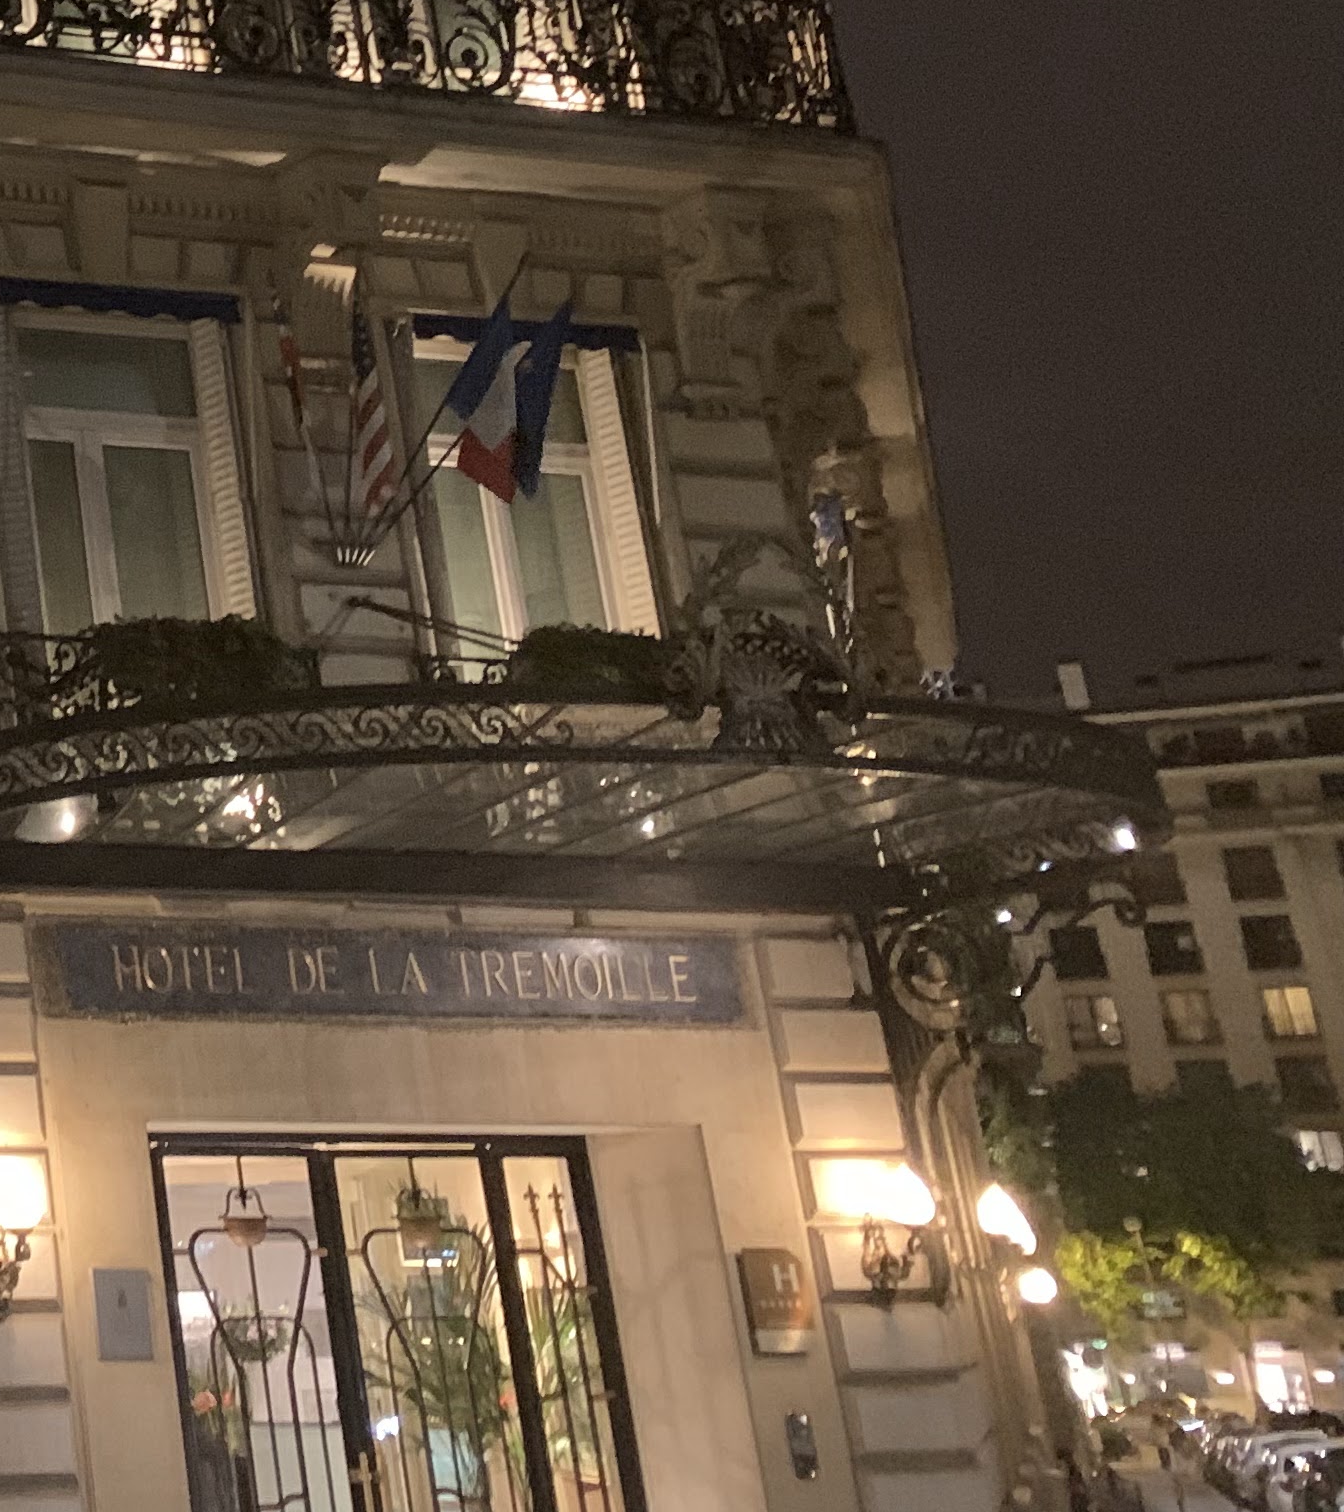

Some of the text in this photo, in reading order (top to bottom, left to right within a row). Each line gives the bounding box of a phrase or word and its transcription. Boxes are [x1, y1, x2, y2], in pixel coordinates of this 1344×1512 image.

[112, 944, 698, 1003] HOTEL DE LA TREMOILLE
[772, 1263, 801, 1294] H
